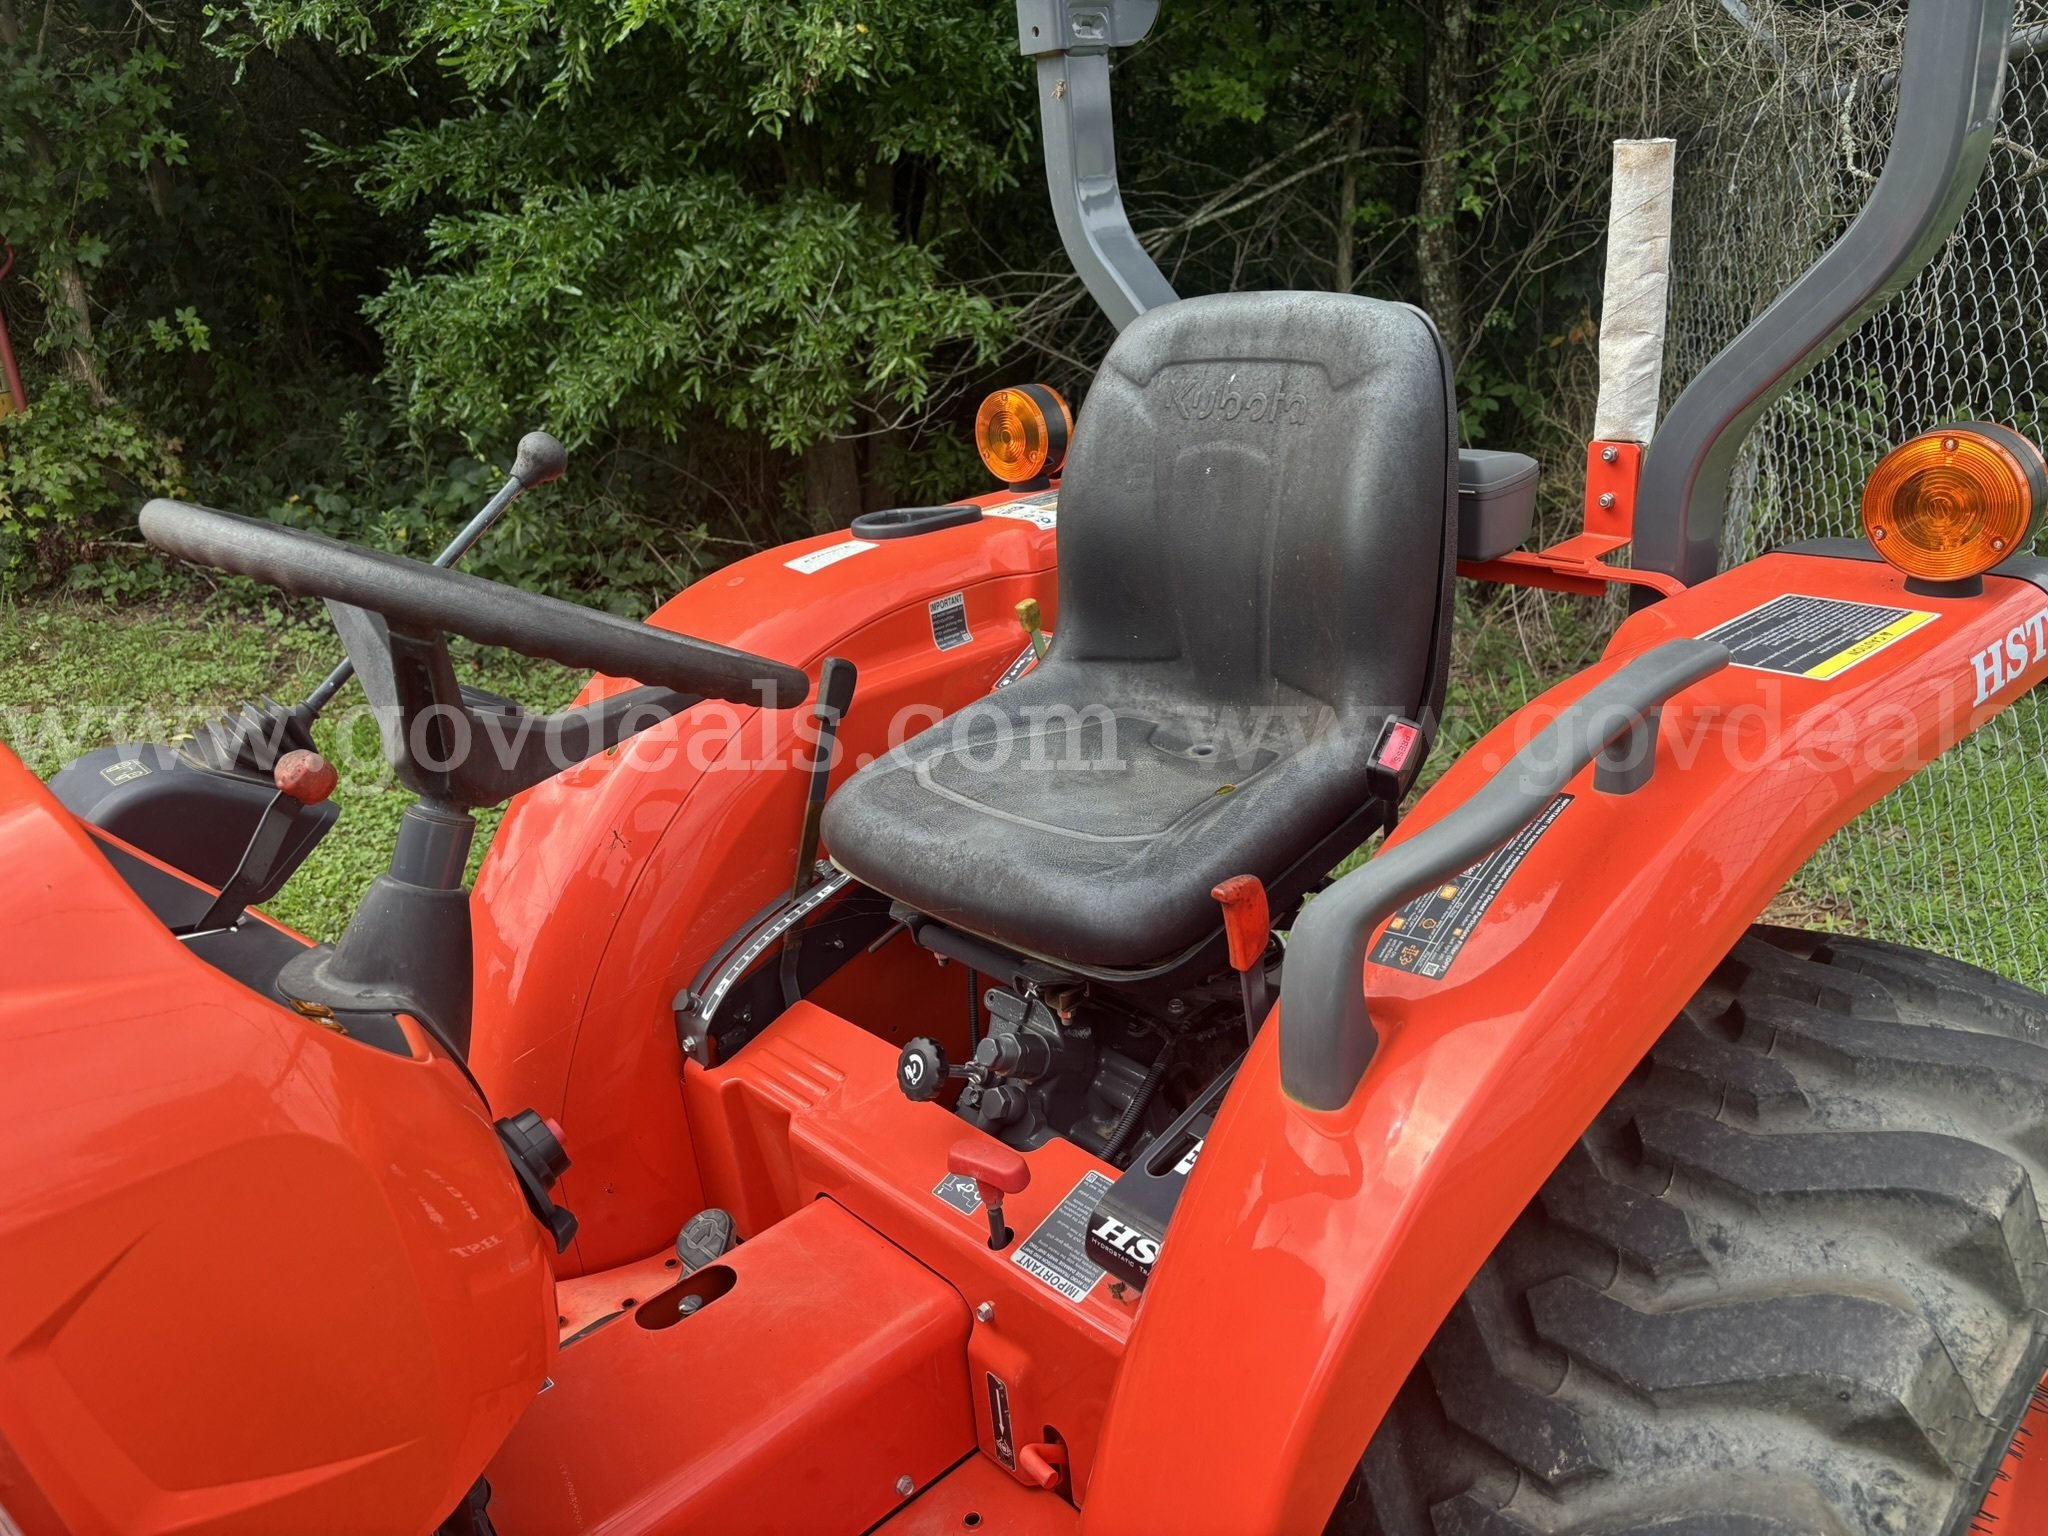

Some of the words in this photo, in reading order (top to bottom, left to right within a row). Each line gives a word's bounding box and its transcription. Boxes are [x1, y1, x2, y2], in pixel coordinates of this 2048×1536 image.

[1164, 379, 1309, 425] Kubota
[930, 594, 962, 612] IMPORTANT
[1970, 607, 2048, 708] HST
[1393, 735, 1411, 762] PRESS
[1091, 1237, 1135, 1268] HYDROSTATIC
[1092, 1215, 1165, 1266] HS
[1016, 1255, 1080, 1299] IMPORTANT
